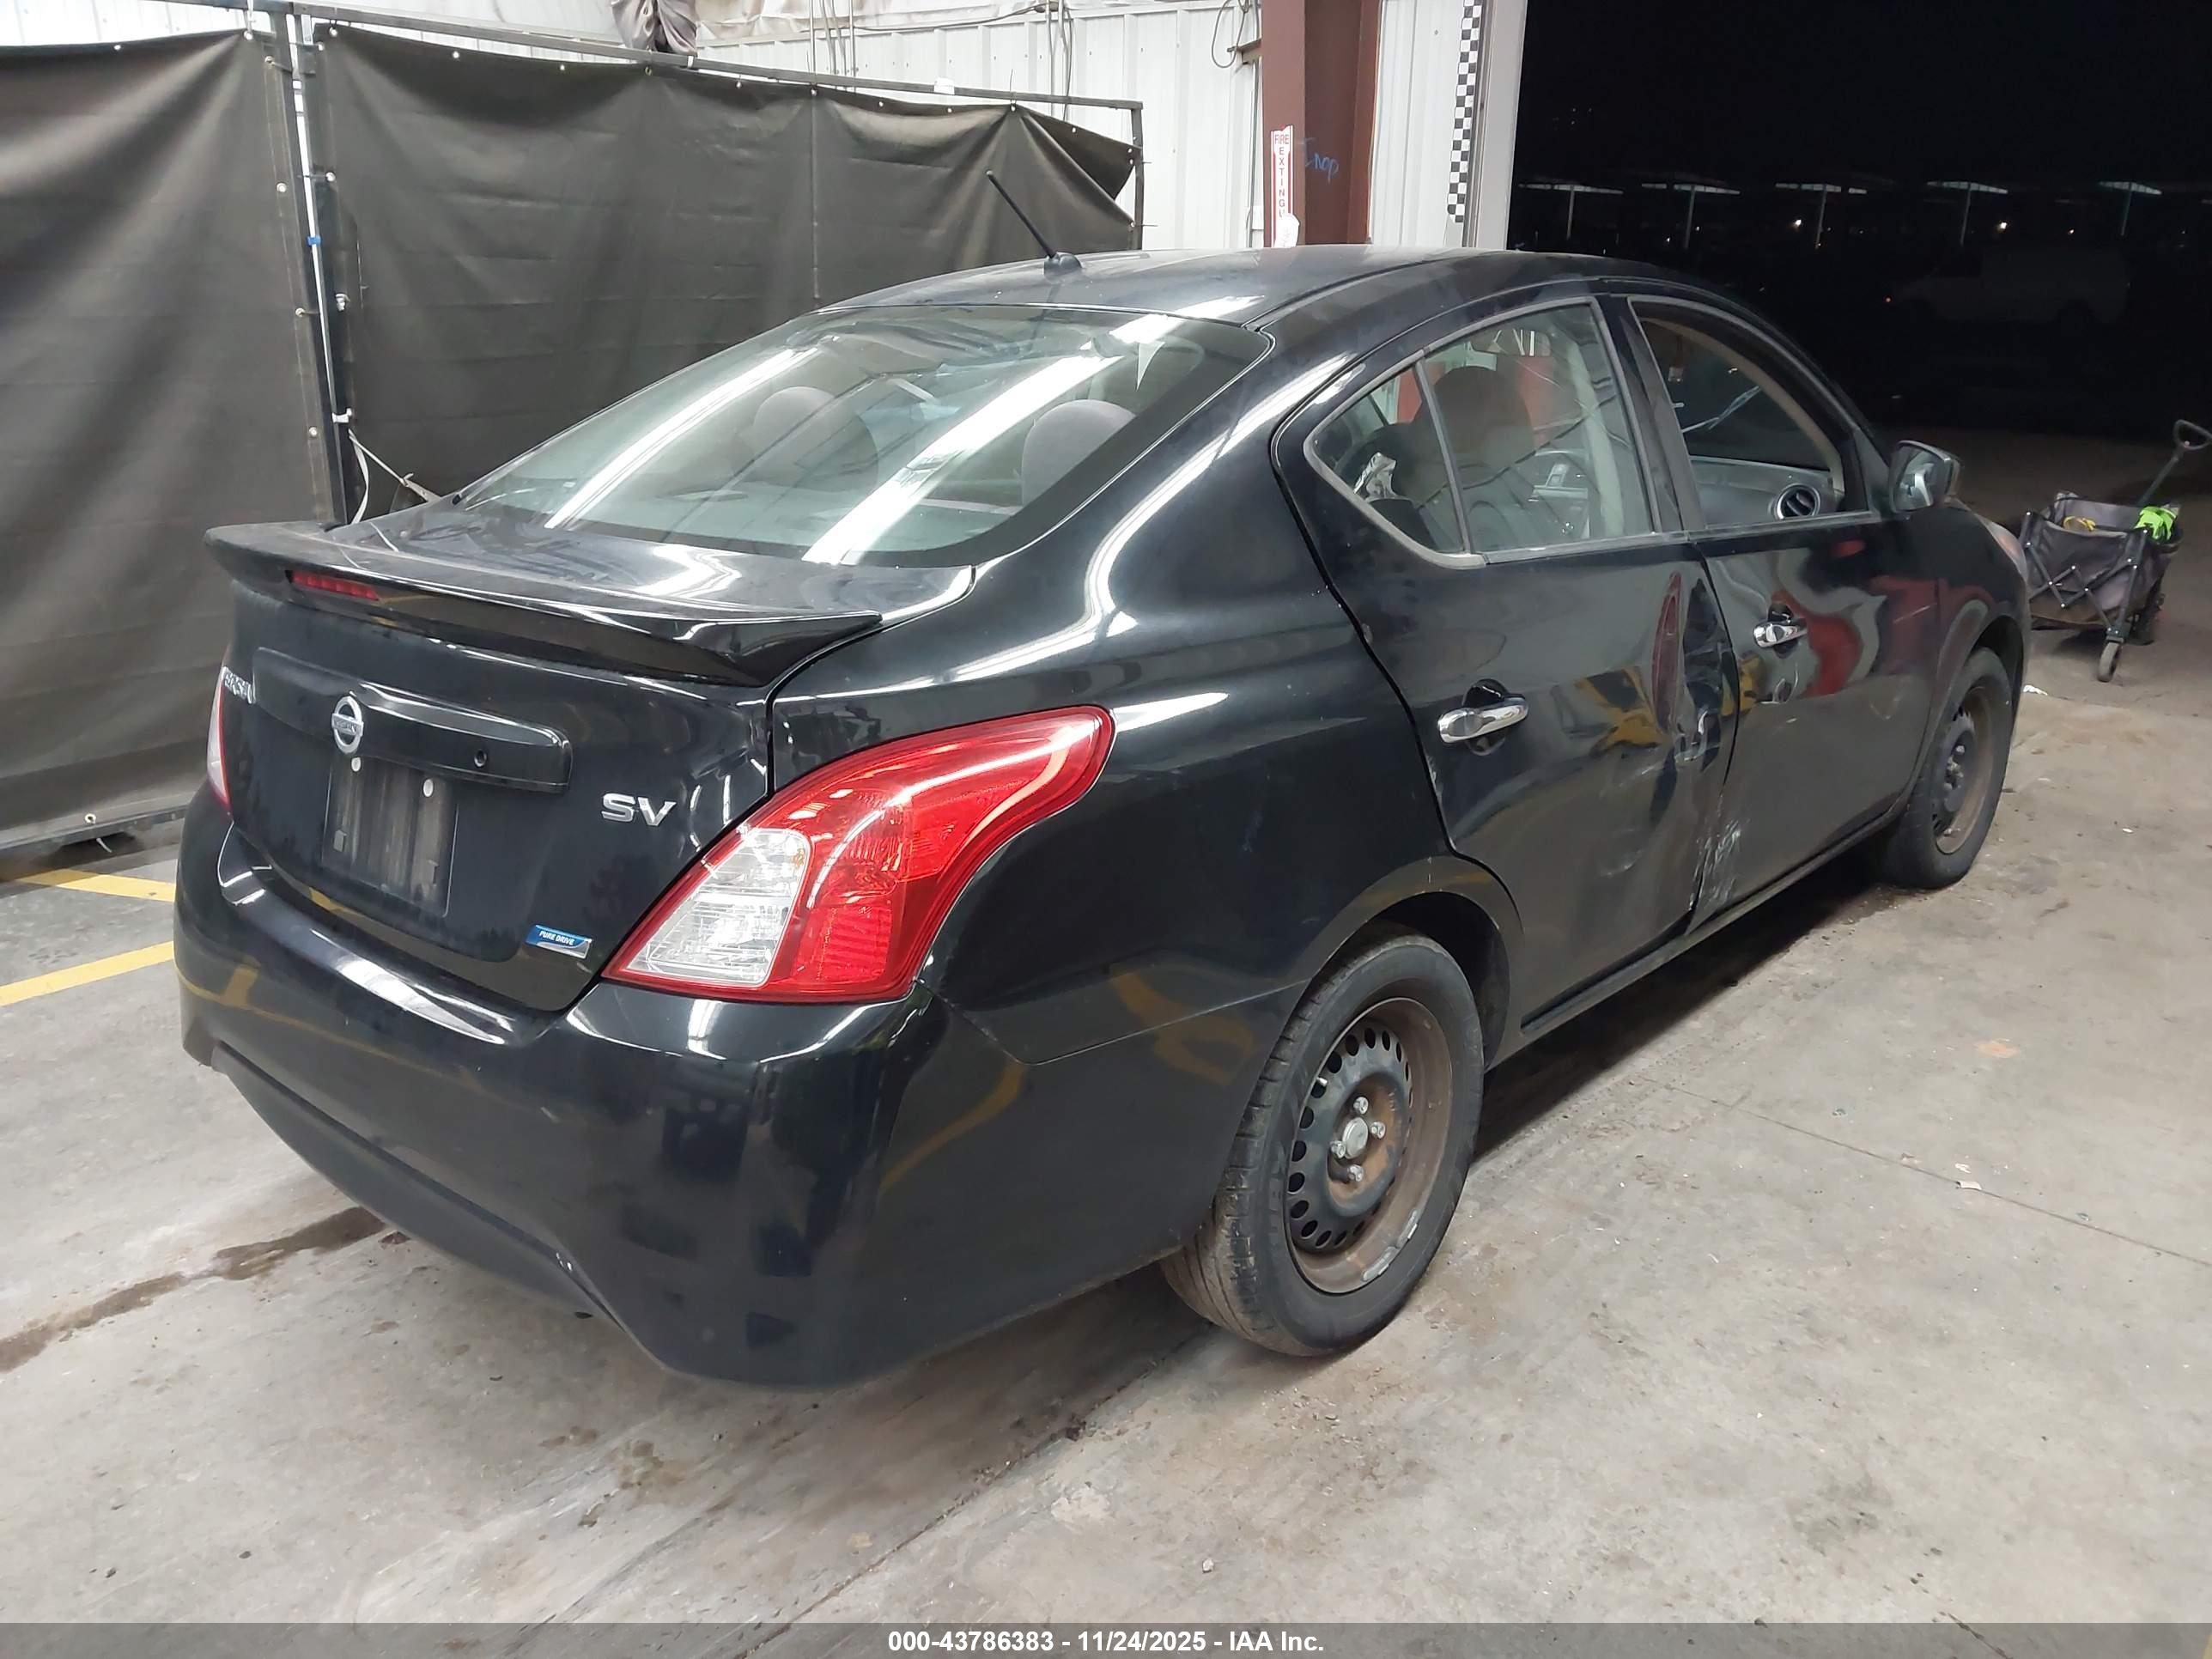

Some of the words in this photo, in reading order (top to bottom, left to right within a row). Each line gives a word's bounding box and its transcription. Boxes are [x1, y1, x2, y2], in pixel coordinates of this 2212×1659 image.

[1274, 133, 1290, 145] FIRE
[601, 793, 677, 826] SV
[538, 930, 556, 941] PURE
[556, 934, 575, 945] DRIVE
